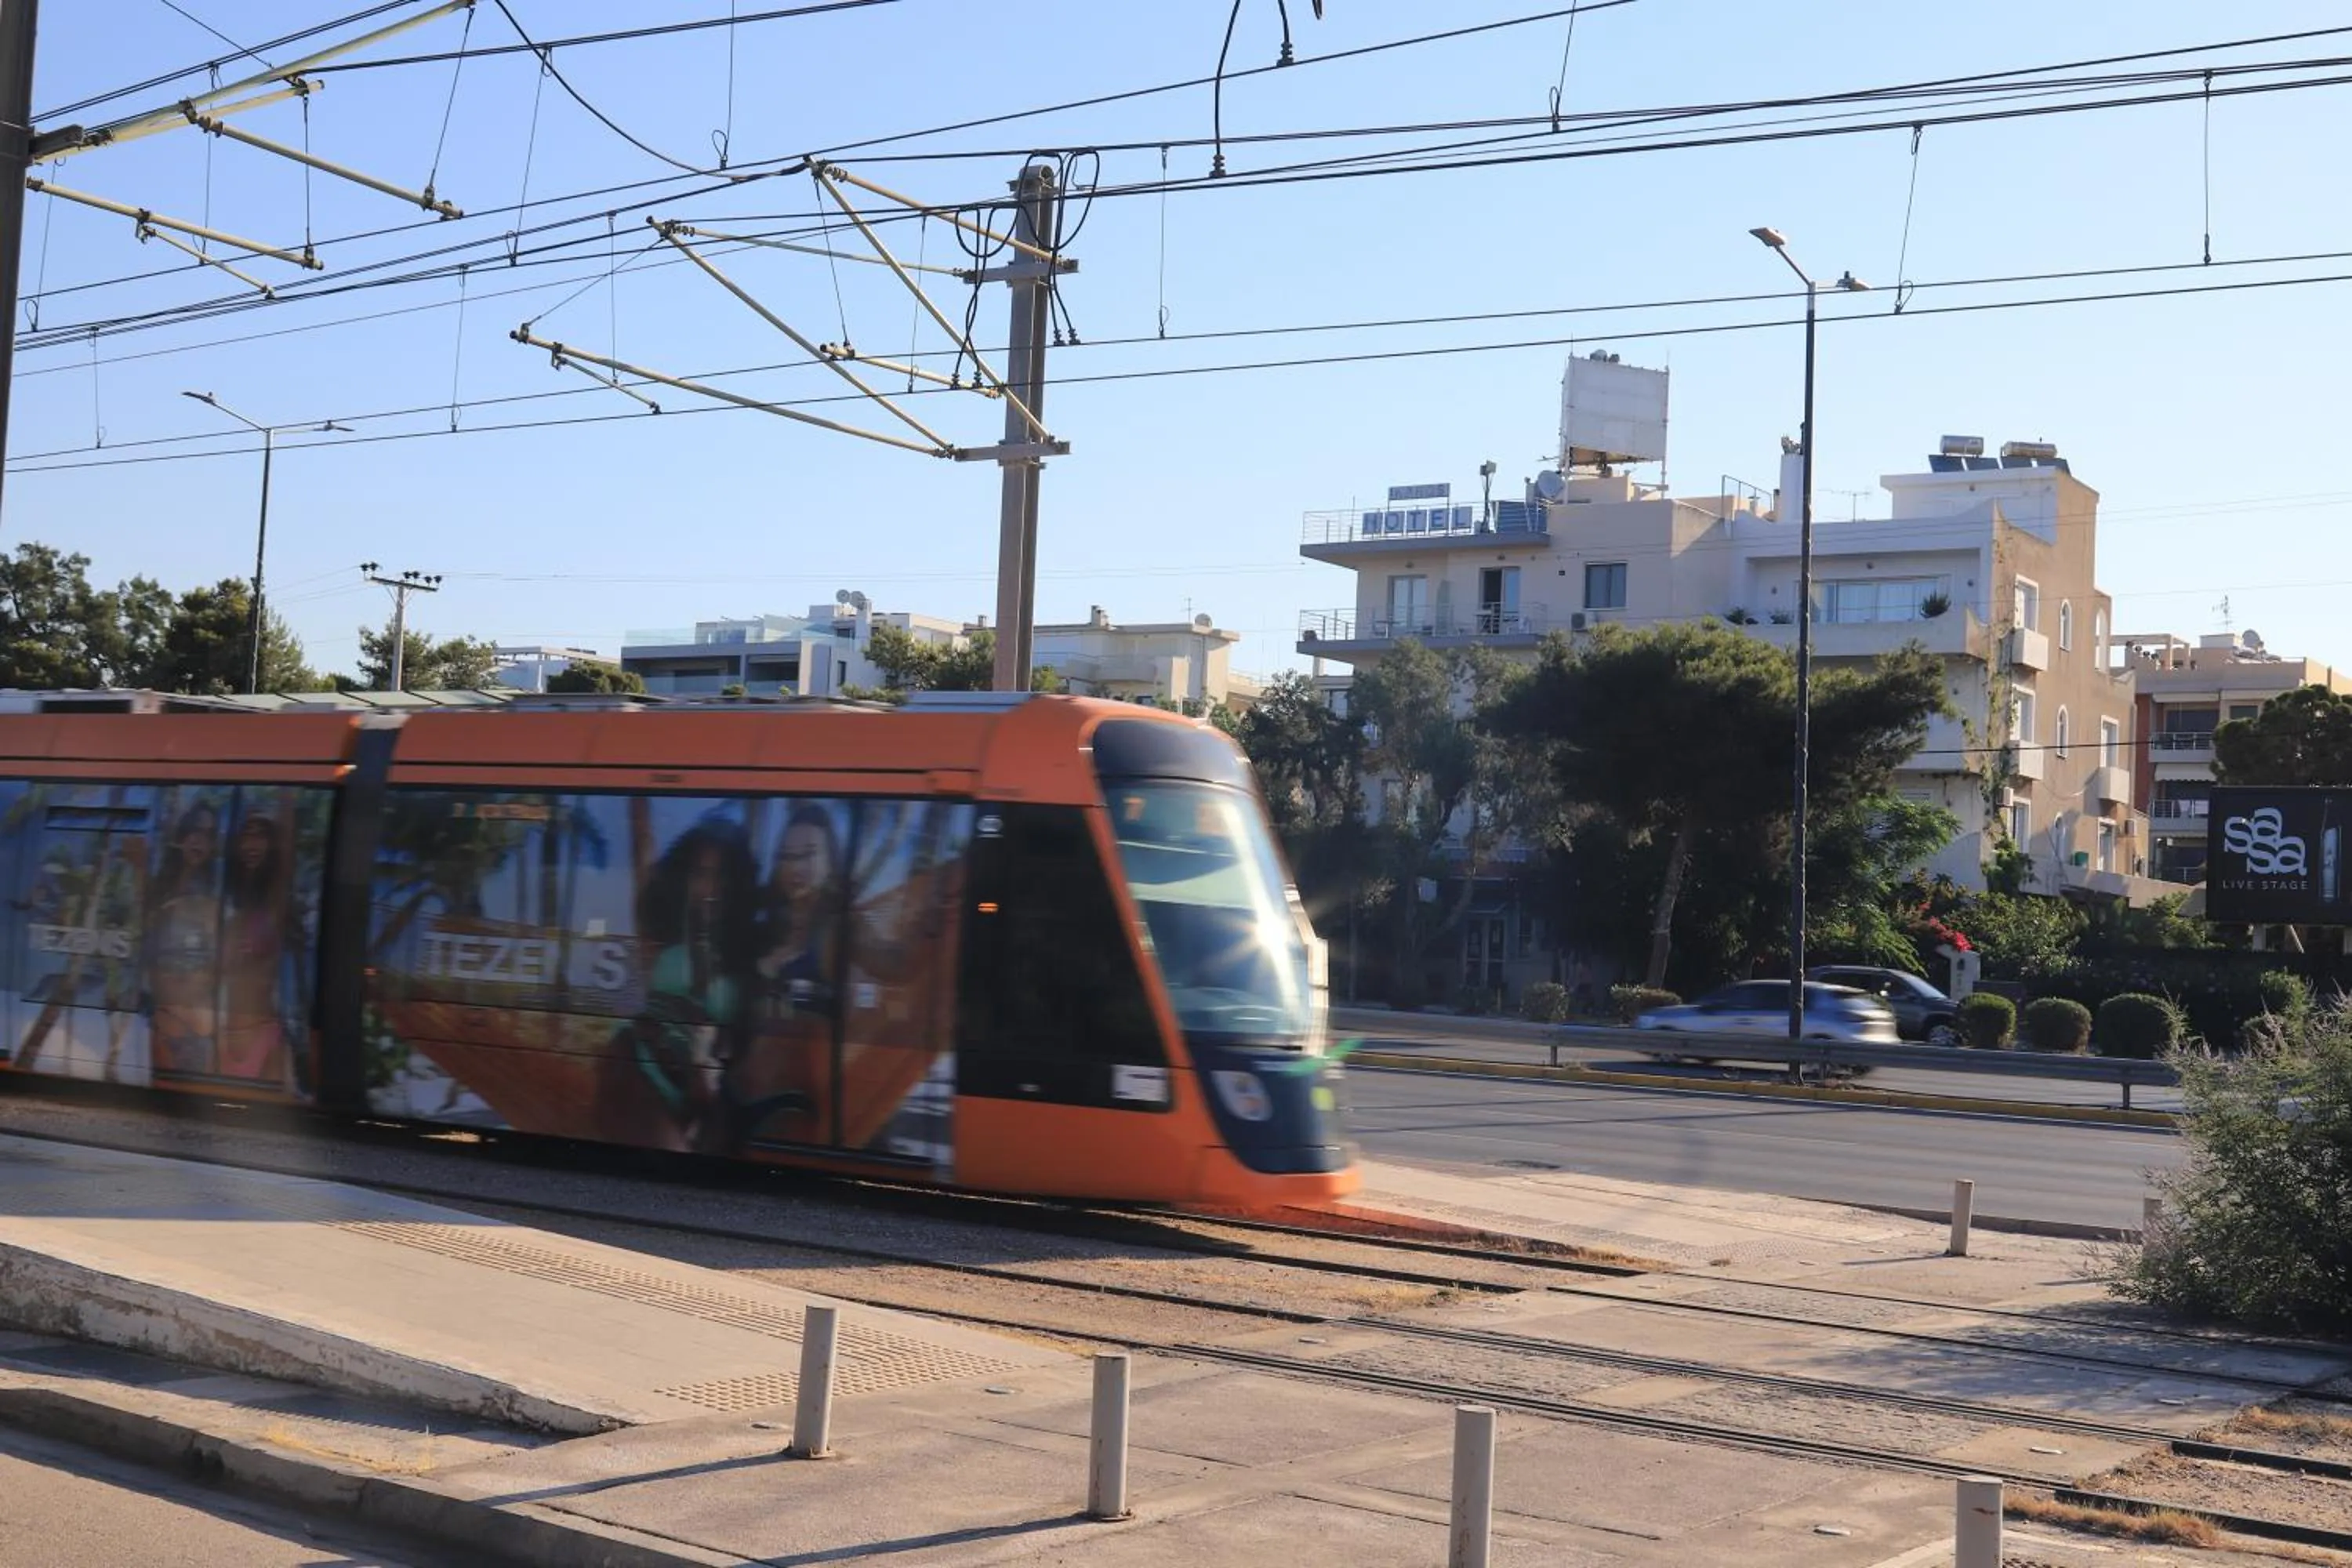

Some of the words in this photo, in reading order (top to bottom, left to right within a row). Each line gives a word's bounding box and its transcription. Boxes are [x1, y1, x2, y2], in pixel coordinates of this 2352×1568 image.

[1364, 510, 1466, 530] HOTEL
[2223, 880, 2255, 890] LIVE
[2260, 880, 2309, 891] STAGE
